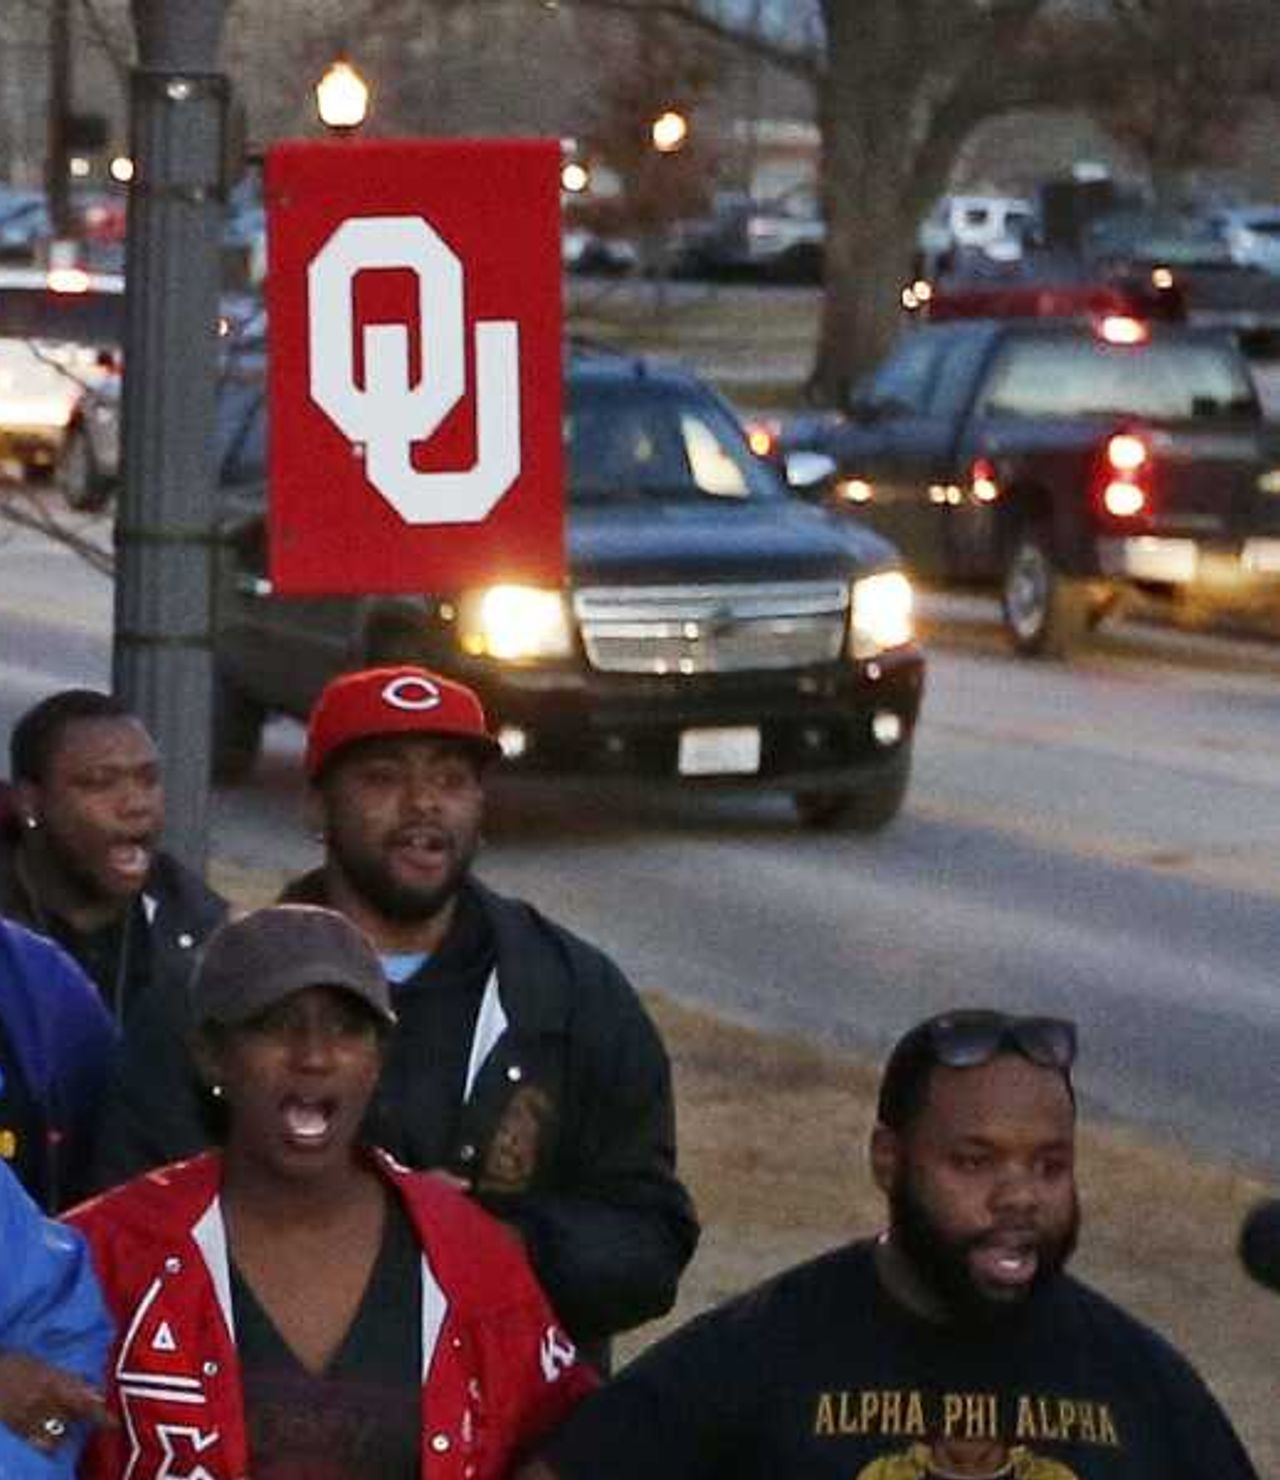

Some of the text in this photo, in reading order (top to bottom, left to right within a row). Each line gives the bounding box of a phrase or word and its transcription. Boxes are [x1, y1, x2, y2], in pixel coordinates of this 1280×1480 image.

[307, 215, 521, 525] OU
[381, 675, 442, 711] C
[814, 1389, 1120, 1447] ALPHA PHI ALPHA
